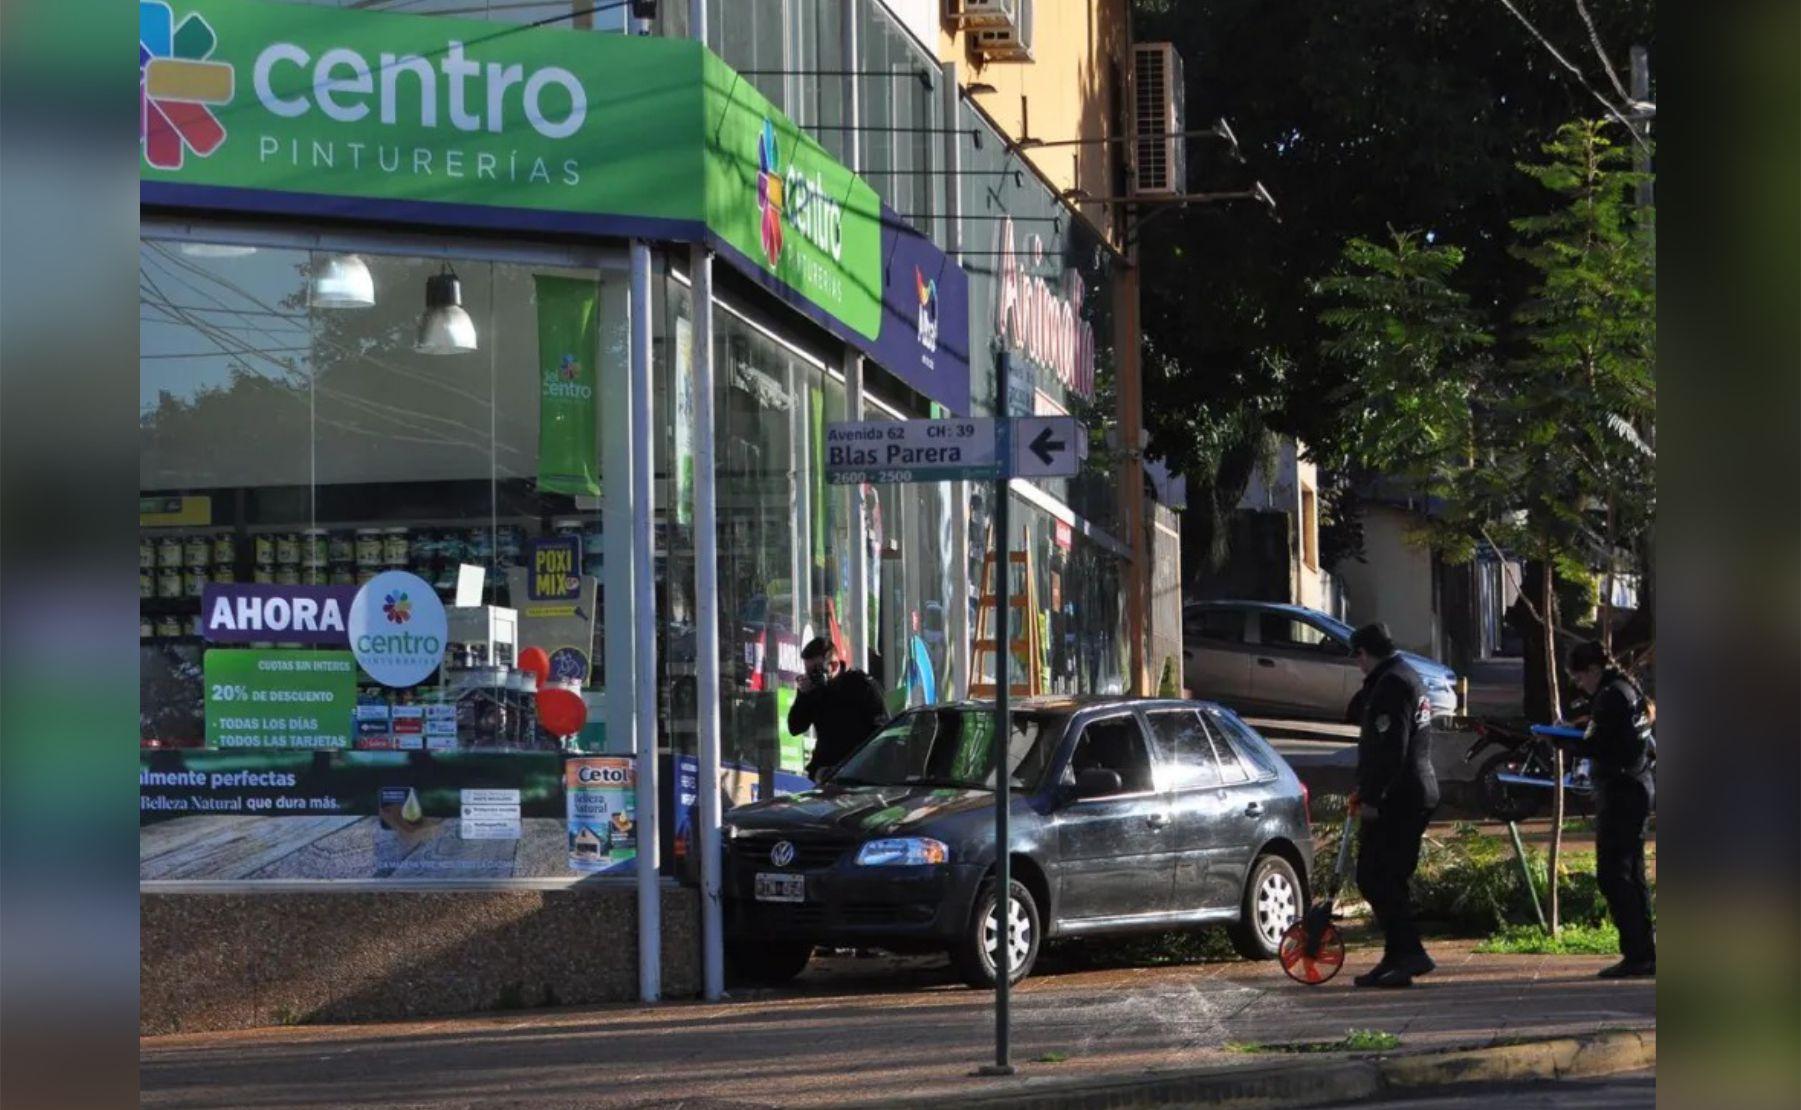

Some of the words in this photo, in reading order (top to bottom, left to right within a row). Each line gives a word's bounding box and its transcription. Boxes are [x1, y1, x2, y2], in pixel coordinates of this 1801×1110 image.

[253, 40, 587, 139] centro
[260, 136, 581, 186] PINTURERÍAS
[785, 164, 841, 261] centro
[543, 381, 592, 399] centro
[828, 427, 883, 441] Avenida
[887, 426, 905, 439] 62
[956, 424, 975, 438] 39
[829, 445, 878, 465] Blas
[886, 443, 962, 464] Parera
[833, 472, 867, 484] 2600
[879, 470, 912, 482] 2500
[536, 550, 572, 572] POXI
[536, 573, 567, 596] MIX
[209, 596, 345, 632] AHORA
[357, 631, 440, 655] centro
[258, 660, 293, 671] CUOTAS
[295, 660, 311, 671] SIN
[211, 684, 248, 701] 20%
[252, 691, 267, 701] DE
[269, 691, 334, 702] DESCUENTO
[219, 718, 259, 730] TODAS
[263, 718, 287, 730] LOS
[289, 716, 318, 730] DÍAS
[220, 735, 260, 747] TODOS
[264, 736, 287, 747] LAS
[290, 736, 347, 747] TARJETAS
[211, 770, 297, 789] perfectas
[579, 766, 630, 783] Cetol
[140, 795, 188, 810] Belleza
[191, 796, 242, 810] Natural
[247, 798, 273, 811] que
[276, 796, 306, 809] dura
